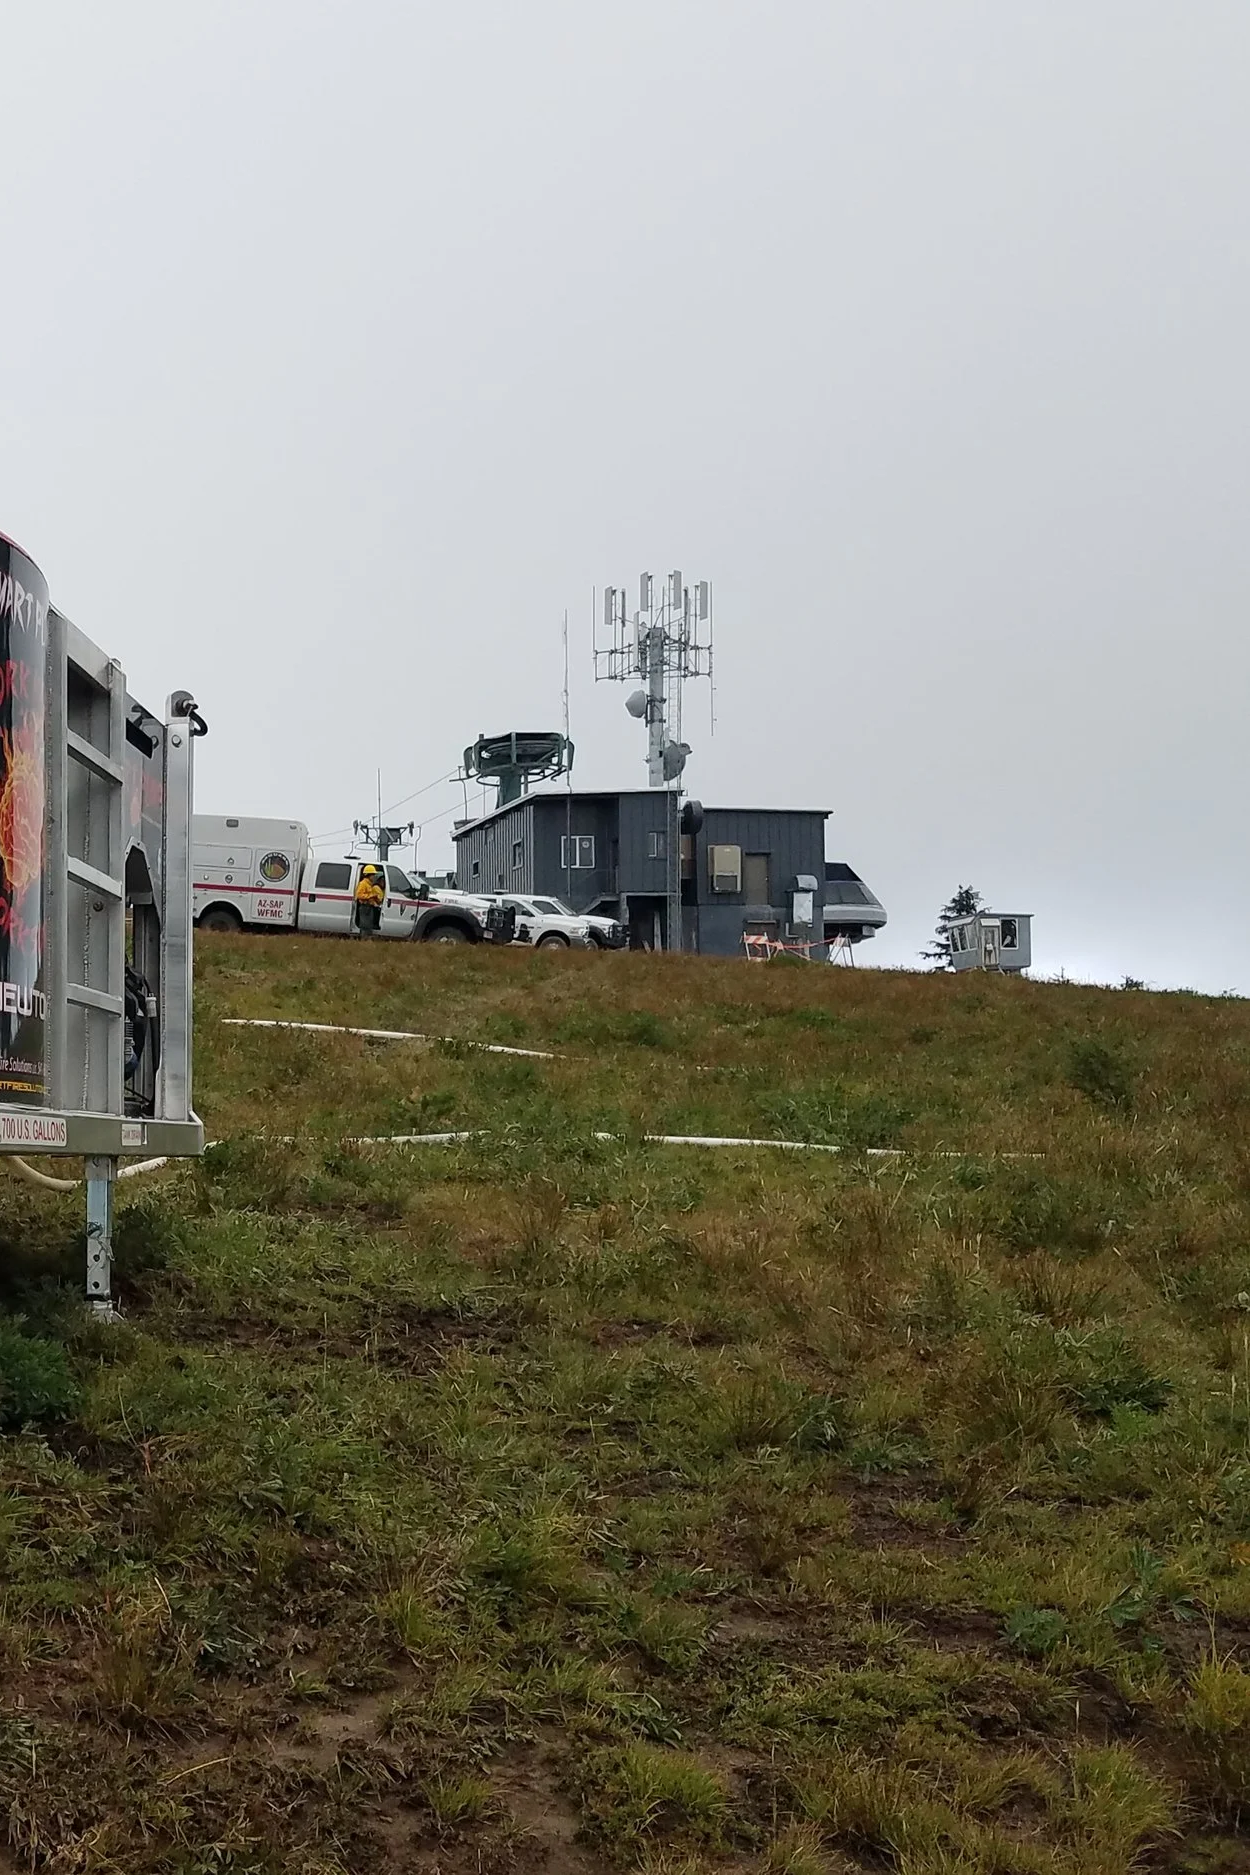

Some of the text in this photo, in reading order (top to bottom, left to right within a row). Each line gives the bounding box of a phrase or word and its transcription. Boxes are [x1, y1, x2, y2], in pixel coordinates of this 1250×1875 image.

[257, 899, 284, 909] AZ-SAP
[257, 908, 283, 918] WFMC
[17, 1118, 32, 1140] U.S.
[32, 1119, 66, 1142] GALLONS
